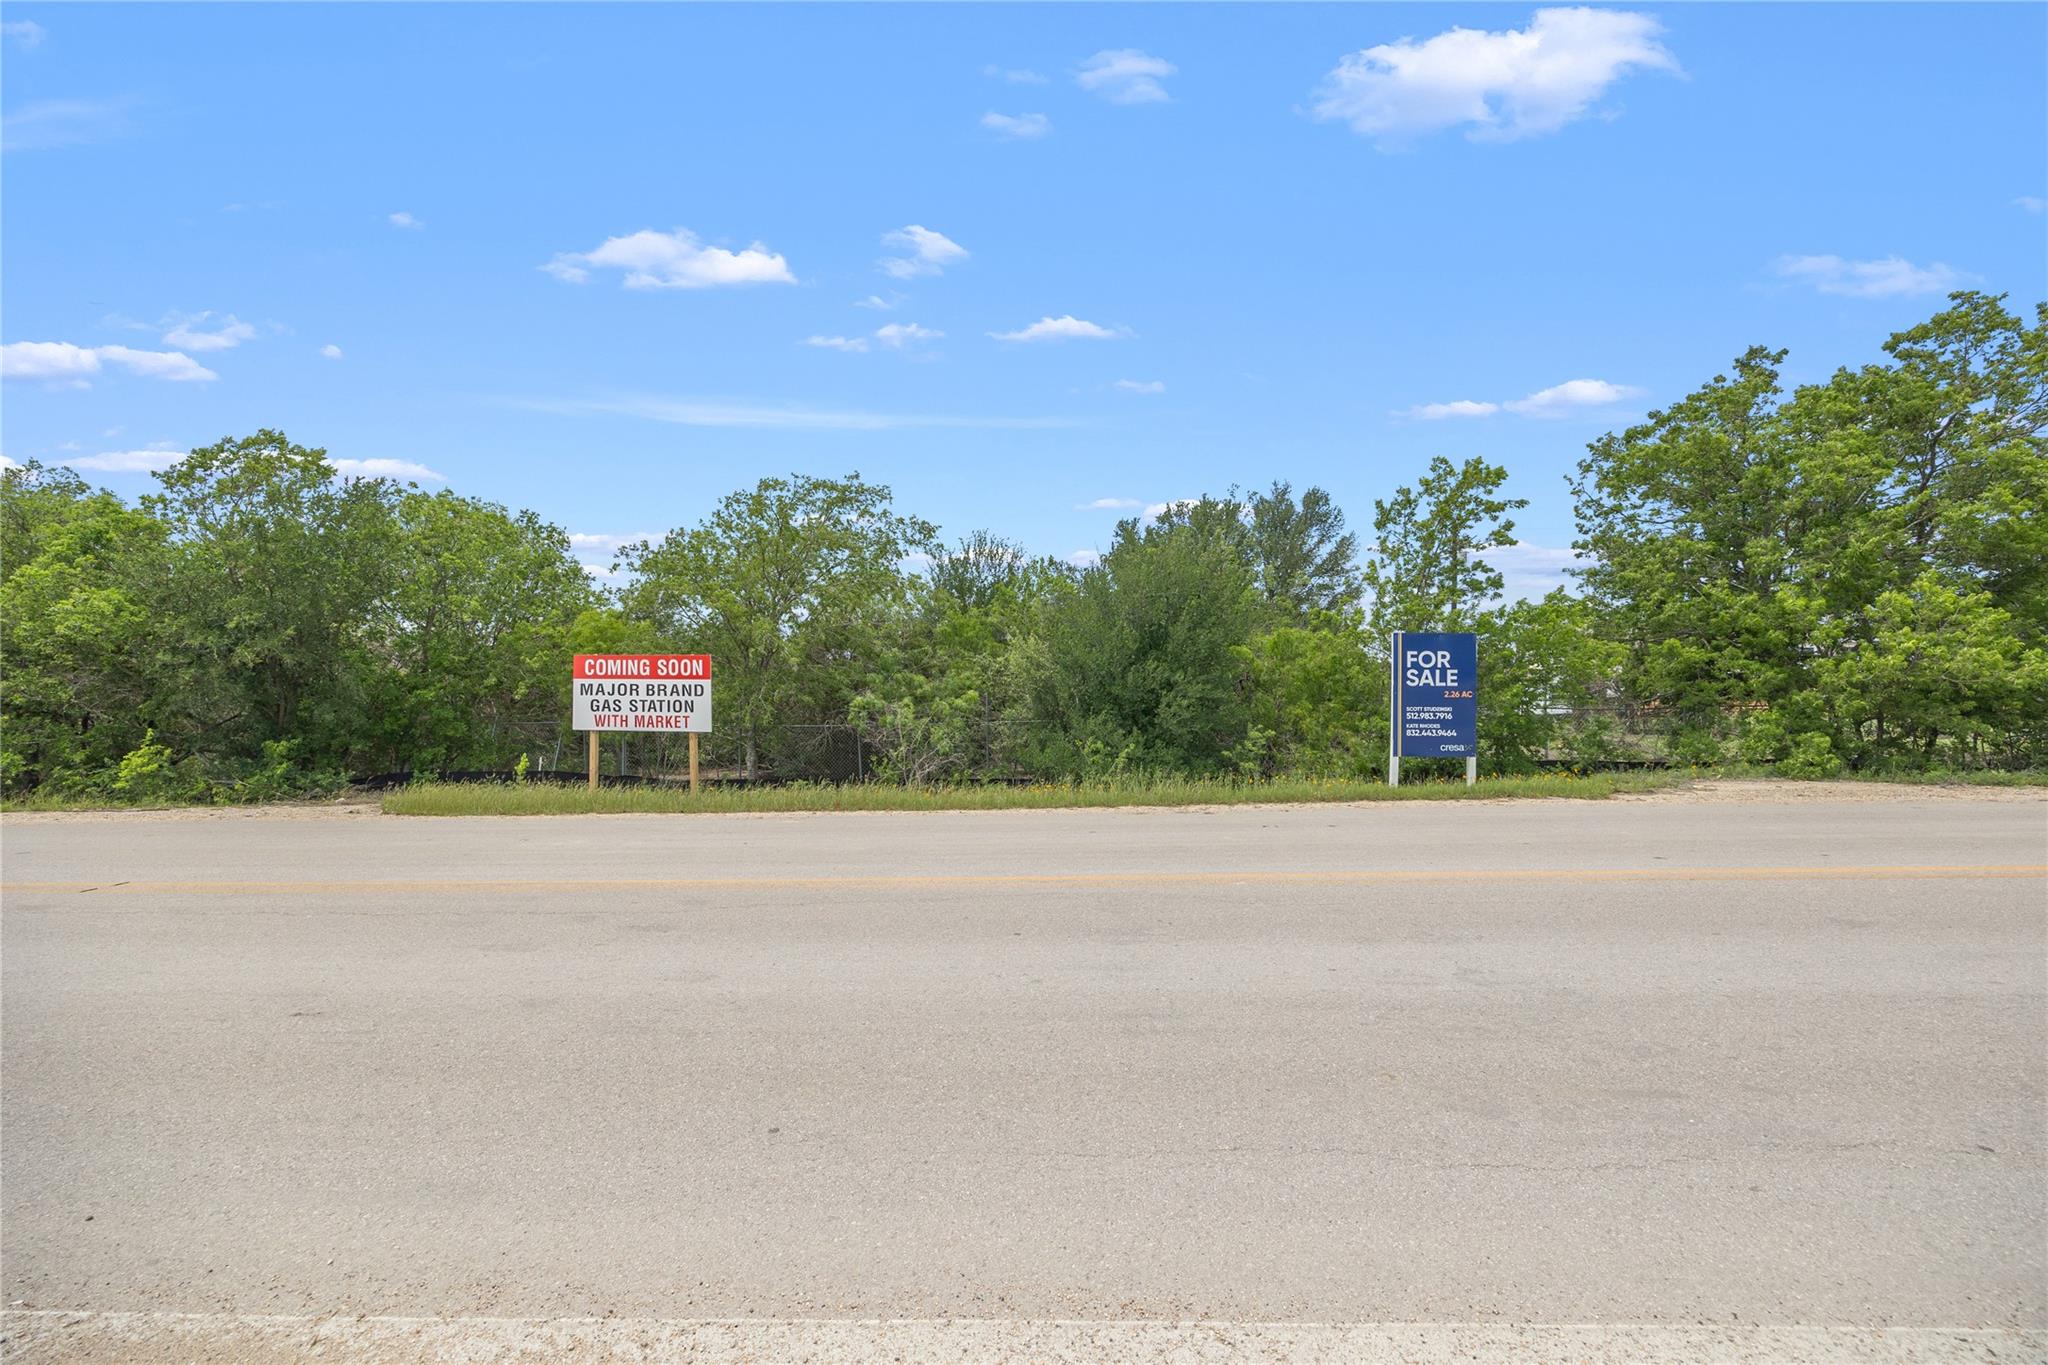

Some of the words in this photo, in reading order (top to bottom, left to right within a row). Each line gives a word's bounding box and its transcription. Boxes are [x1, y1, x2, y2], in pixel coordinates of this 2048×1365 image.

[1406, 651, 1450, 668] FOR
[584, 659, 650, 676] COMING
[657, 659, 703, 676] SOON
[1406, 669, 1458, 687] SALE
[580, 683, 639, 696] MAJOR
[646, 683, 704, 697] BRAND
[590, 699, 621, 712] GAS
[629, 699, 694, 713] STATION
[594, 715, 628, 728] WITH
[634, 715, 690, 729] MARKET
[1440, 744, 1465, 752] cresa
